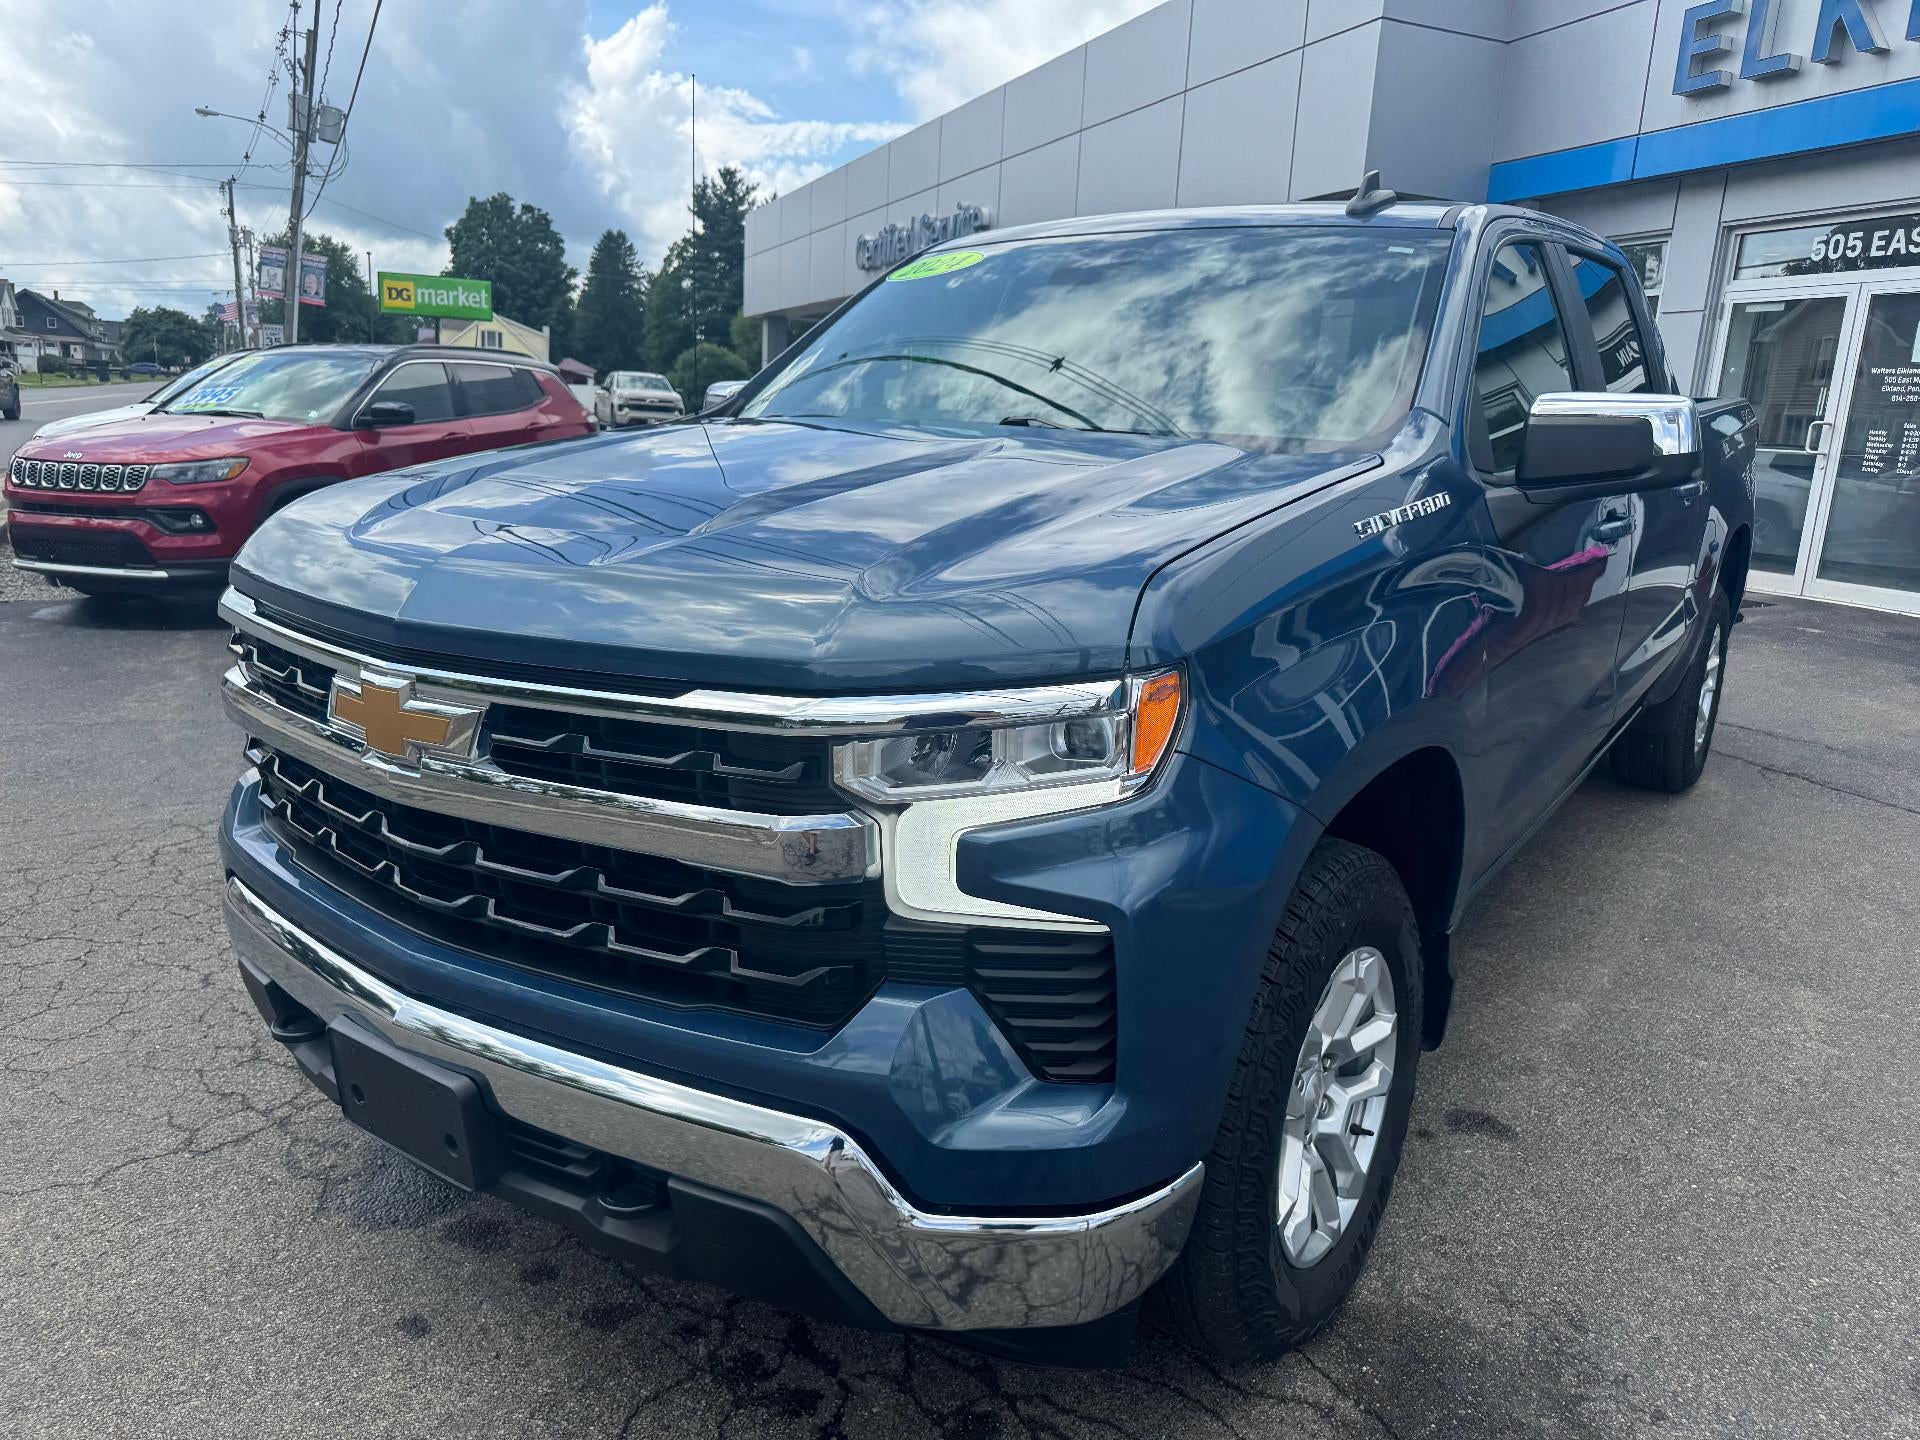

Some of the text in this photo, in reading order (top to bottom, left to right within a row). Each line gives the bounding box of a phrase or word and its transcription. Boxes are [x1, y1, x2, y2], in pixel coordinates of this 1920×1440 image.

[856, 201, 986, 270] Certified Service
[1810, 231, 1864, 262] 505
[387, 286, 489, 308] DG market
[265, 337, 282, 347] 35
[1871, 367, 1896, 375] Walters
[1884, 376, 1897, 384] 505
[1897, 376, 1912, 384] East
[1881, 385, 1906, 393] Elkland,
[63, 450, 83, 460] Jeep
[1351, 491, 1451, 540] SILVERADO
